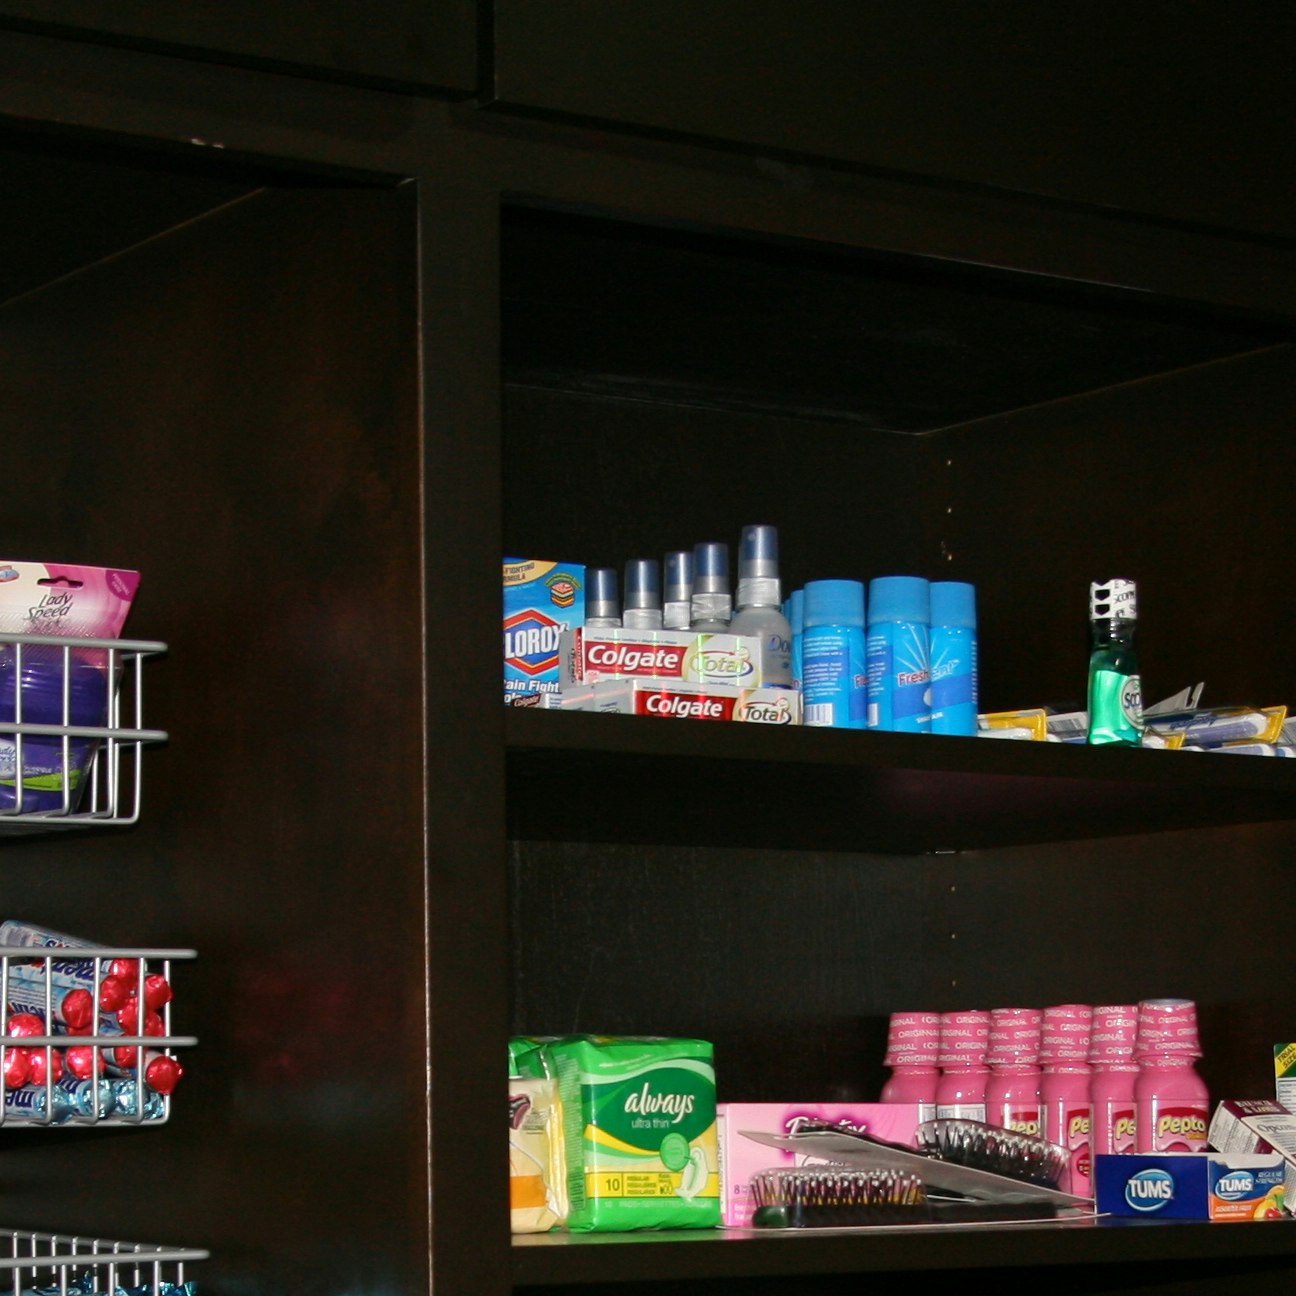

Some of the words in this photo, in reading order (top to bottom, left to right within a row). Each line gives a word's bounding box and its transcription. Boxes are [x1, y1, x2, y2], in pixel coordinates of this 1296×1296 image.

[38, 592, 73, 609] Lady
[504, 623, 569, 659] LOROX
[588, 645, 680, 671] Colgate
[691, 652, 748, 674] Total
[646, 694, 724, 722] Colgate
[743, 704, 789, 722] Total
[624, 1082, 696, 1124] always
[631, 1117, 651, 1129] ultra
[652, 1117, 671, 1129] thin
[605, 1178, 620, 1192] 10
[1128, 1177, 1173, 1200] TUMS
[1218, 1176, 1254, 1193] TUMS
